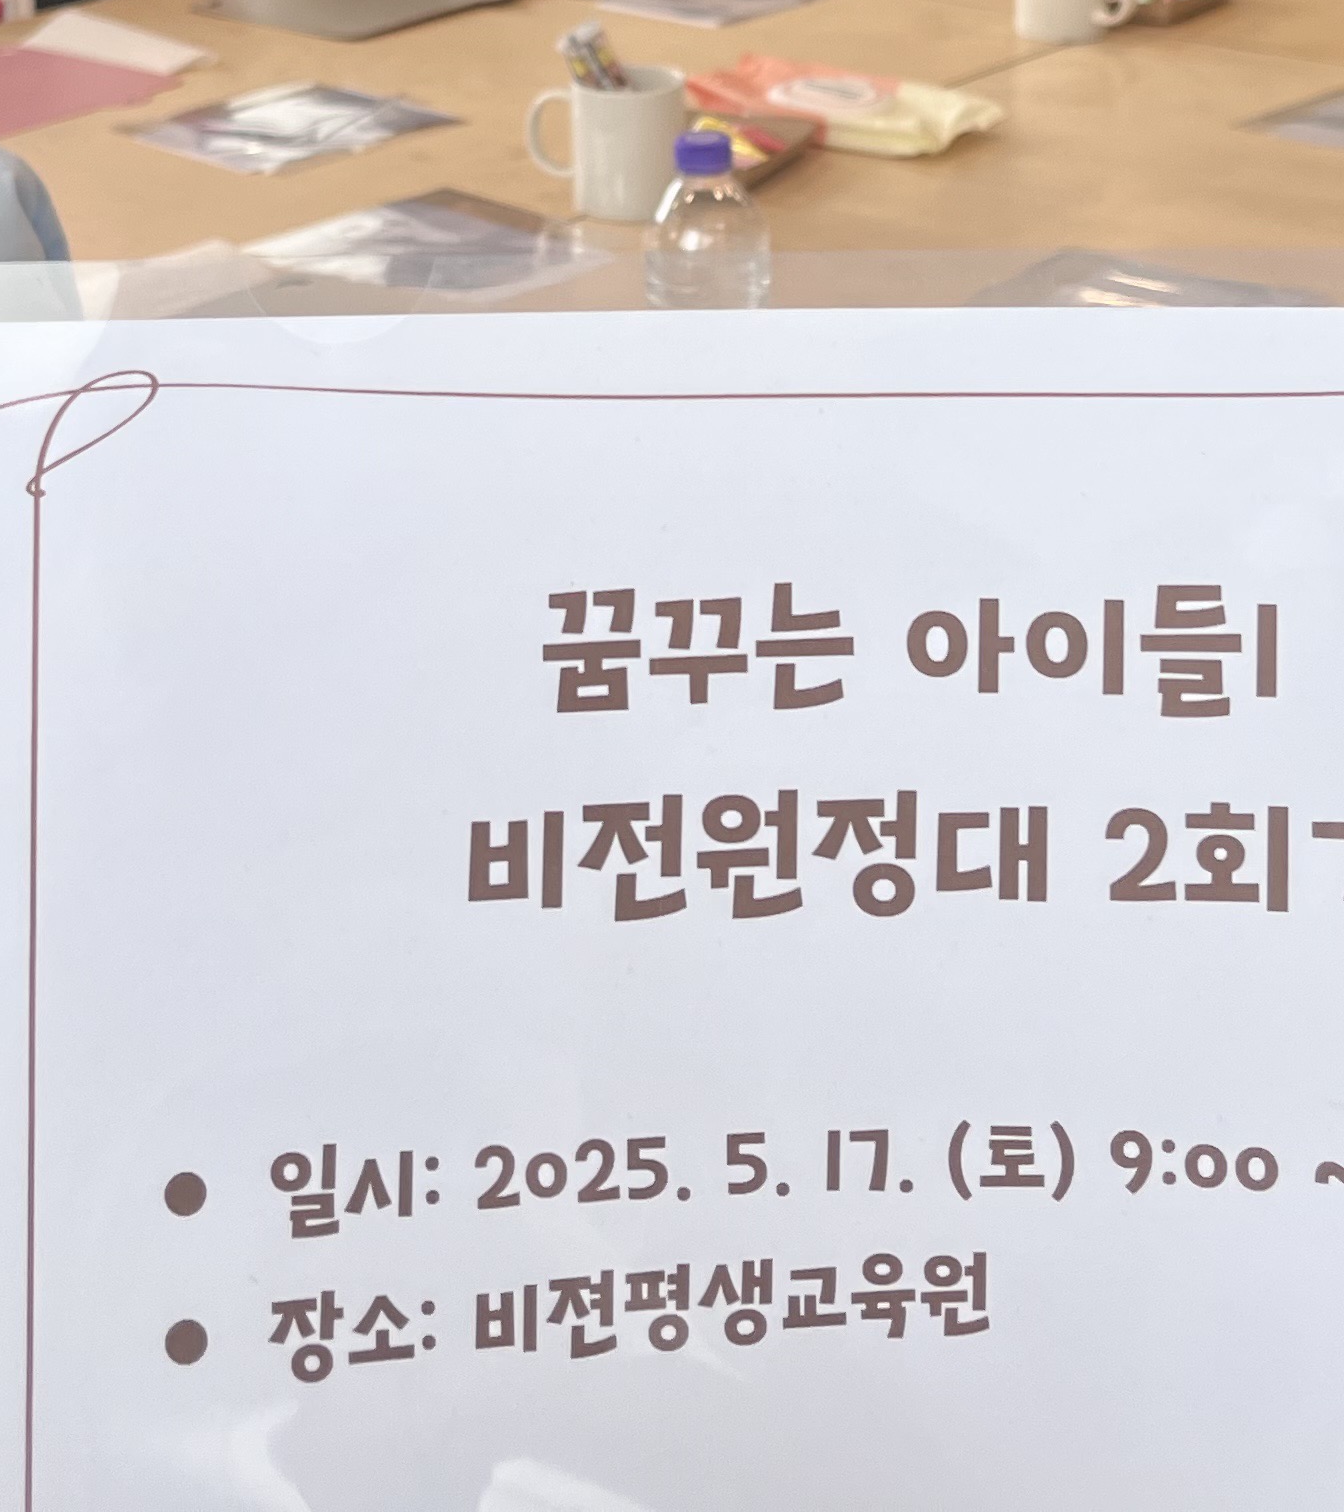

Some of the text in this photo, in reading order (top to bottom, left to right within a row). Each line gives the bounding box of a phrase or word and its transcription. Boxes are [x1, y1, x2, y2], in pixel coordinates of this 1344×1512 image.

[541, 581, 855, 715] 꿈꾸는
[466, 787, 1049, 923] 비전원정대
[269, 1142, 441, 1239] 일시:
[473, 1134, 692, 1211] 2025.
[725, 1131, 791, 1197] 5.
[825, 1127, 915, 1193] 17.
[947, 1118, 1076, 1203] (토)
[1109, 1128, 1280, 1195] 9:00
[266, 1289, 438, 1385] 장소:
